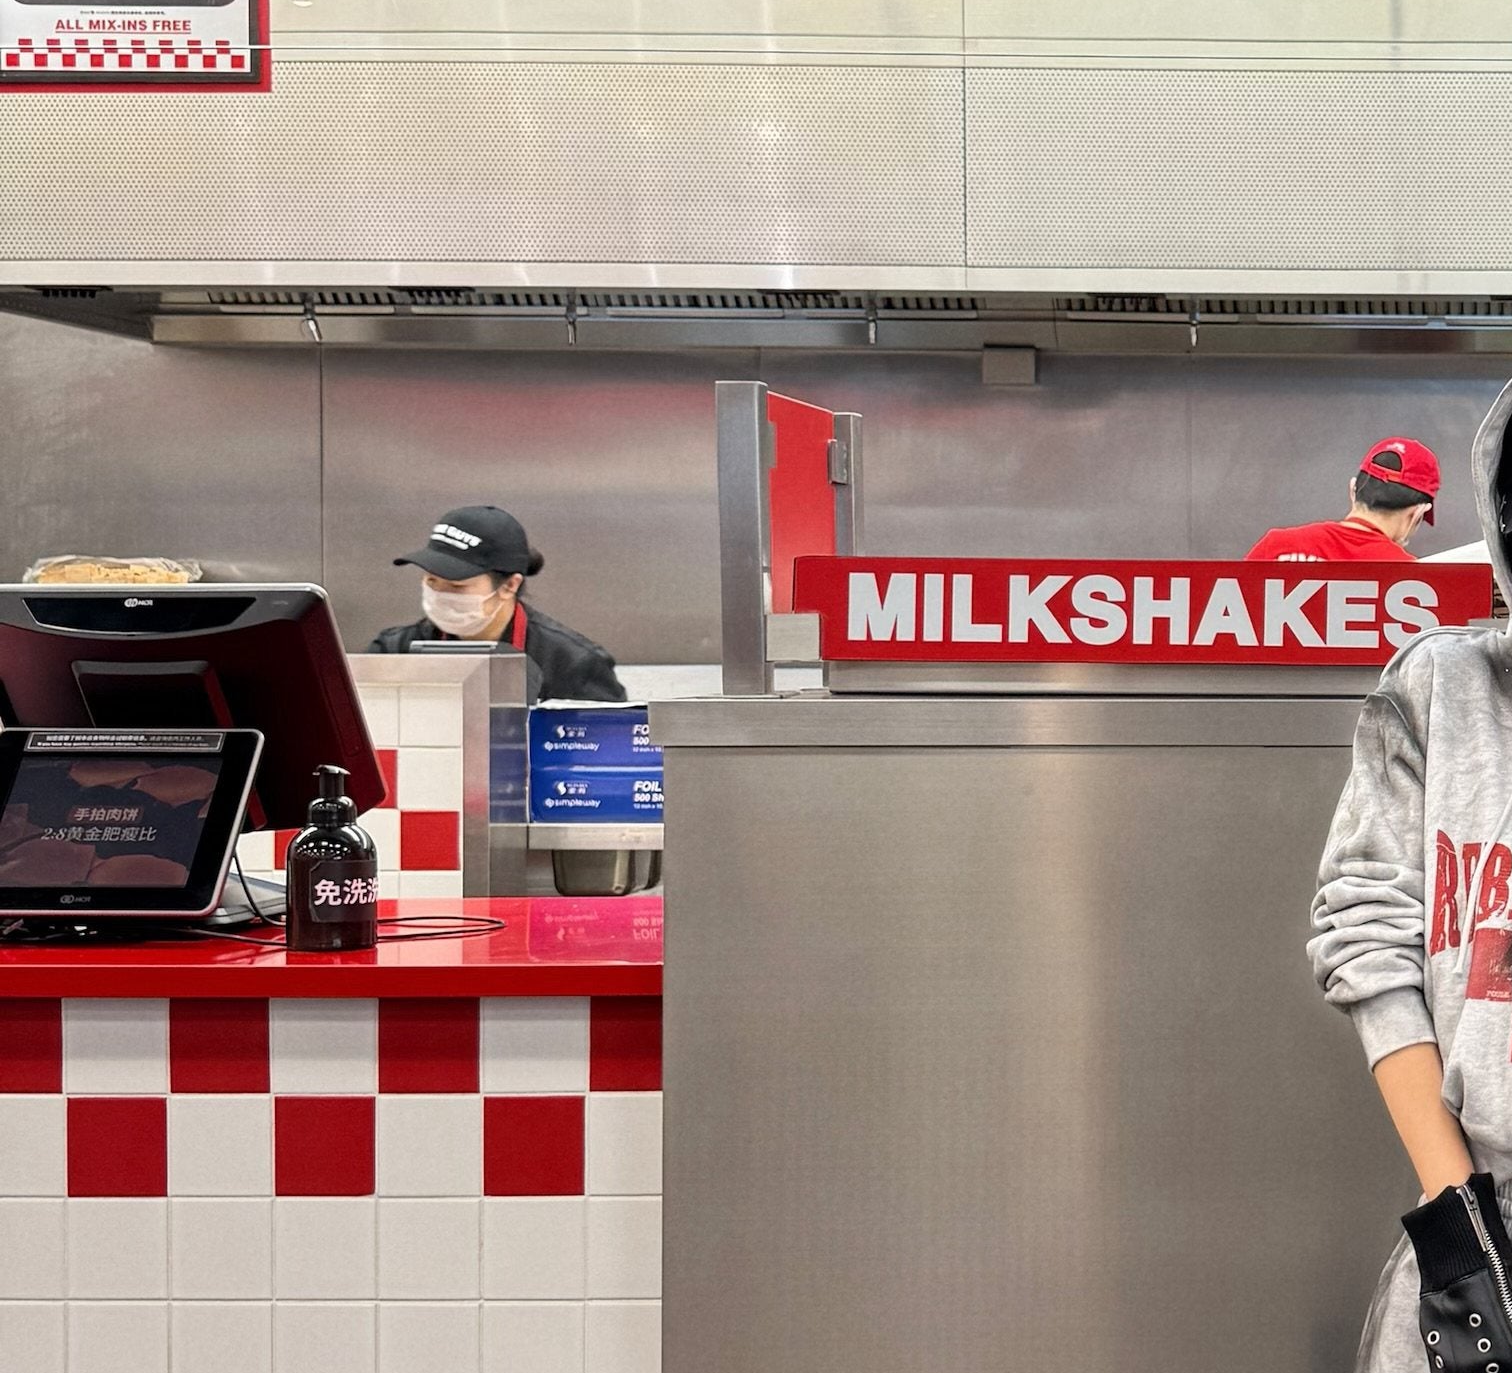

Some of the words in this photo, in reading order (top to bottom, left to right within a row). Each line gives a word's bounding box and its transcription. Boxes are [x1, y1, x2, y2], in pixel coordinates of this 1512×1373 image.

[55, 19, 84, 30] ALL
[88, 19, 148, 31] MIX-INS
[152, 20, 192, 31] FREE
[846, 572, 1439, 649] MILKSHAKES
[633, 724, 650, 735] FO
[633, 780, 662, 792] FOIL
[651, 792, 665, 802] Sh
[74, 808, 139, 822] 手拍肉饼
[41, 827, 157, 842] 2:8黄金肥瘦比
